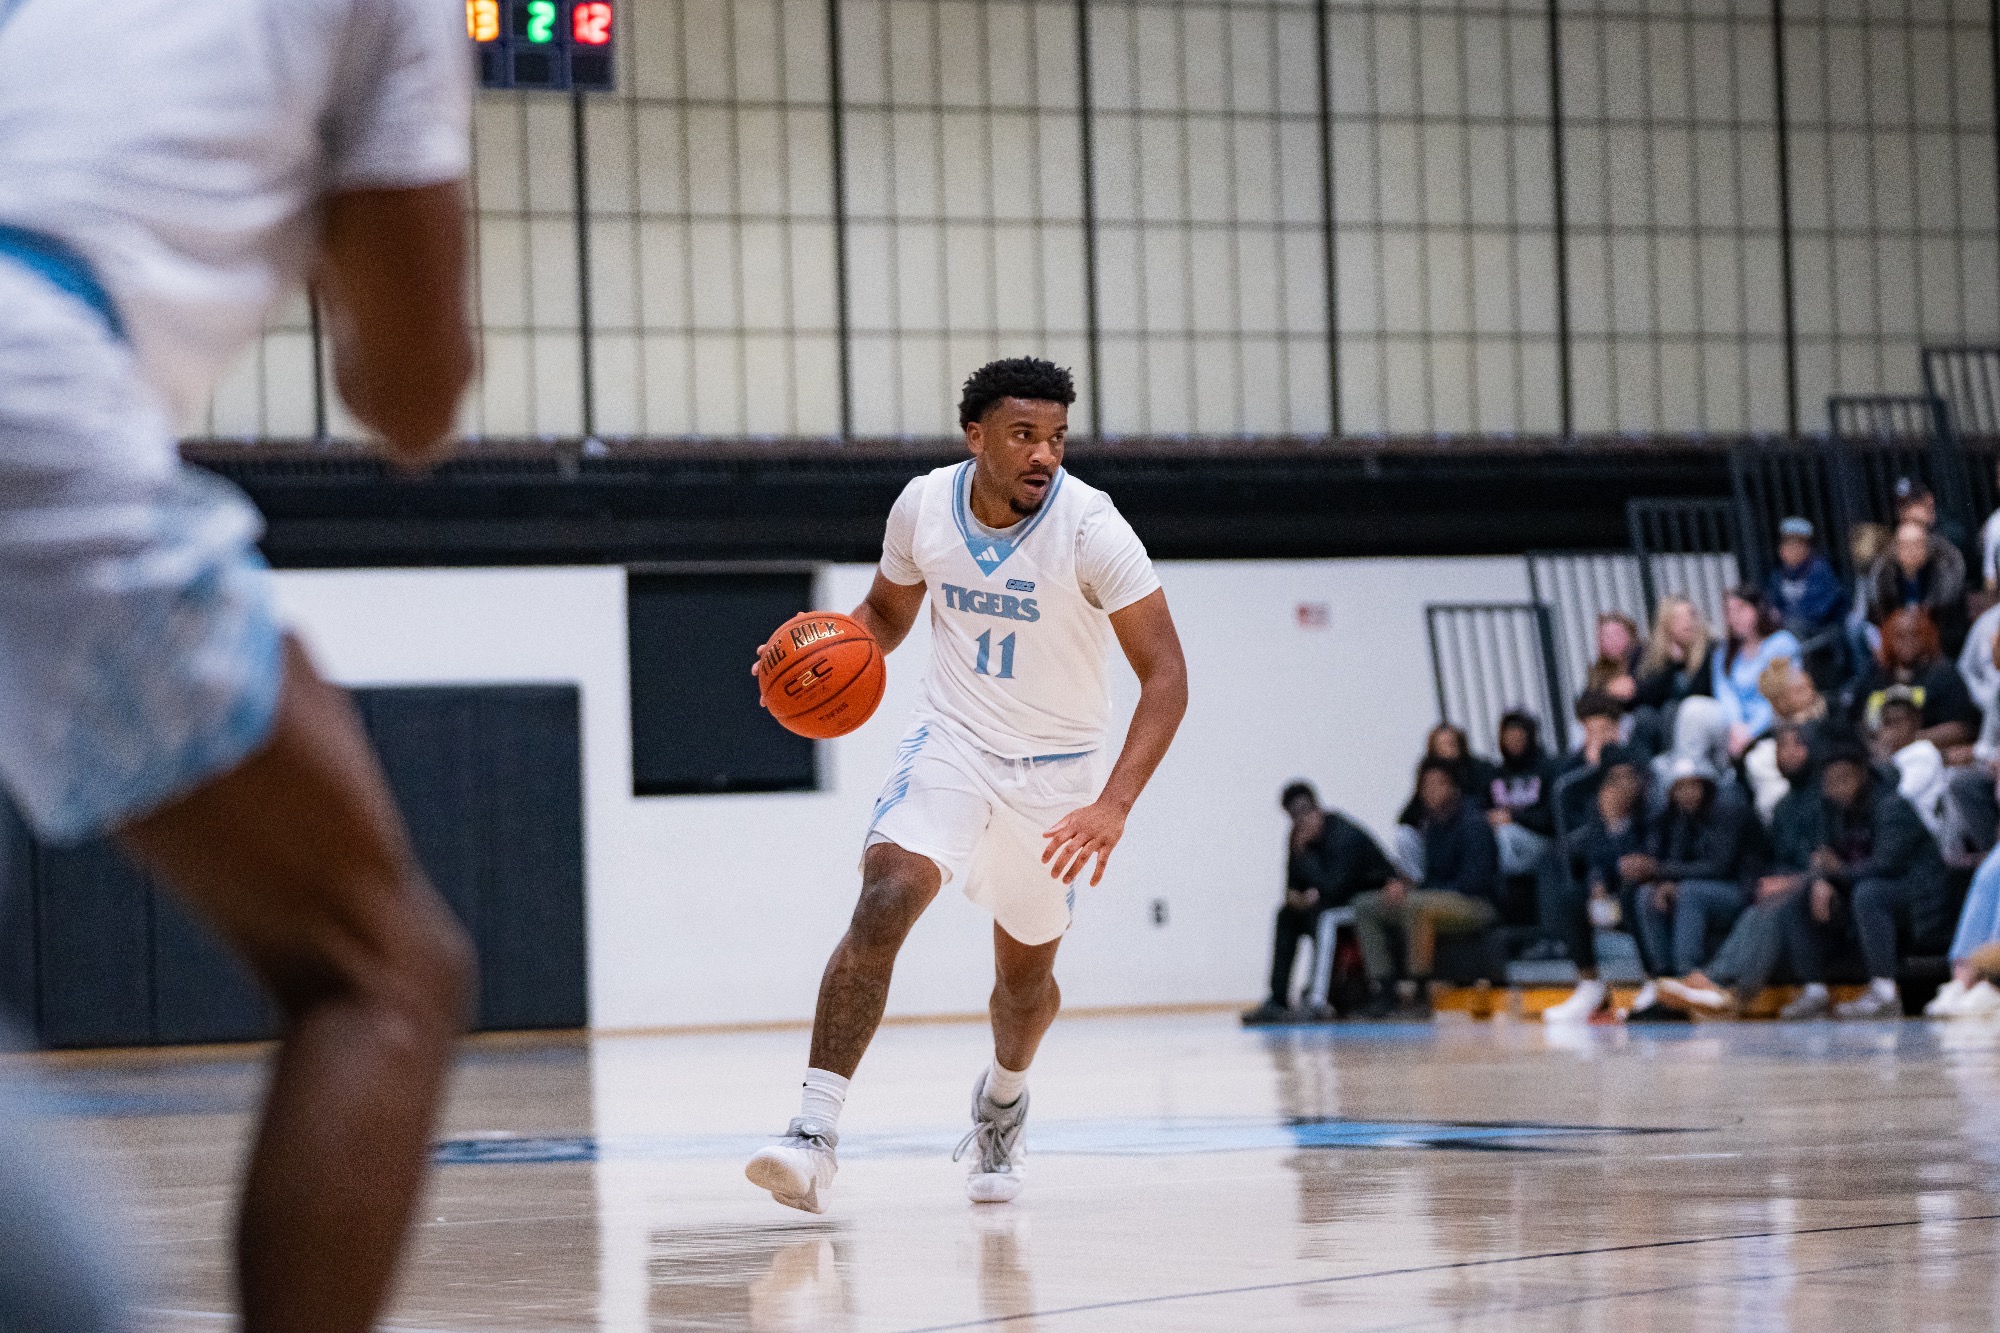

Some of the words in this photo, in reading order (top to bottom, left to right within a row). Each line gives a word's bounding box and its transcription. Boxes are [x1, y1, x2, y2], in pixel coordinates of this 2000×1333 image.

[527, 0, 556, 43] 2
[573, 2, 613, 45] 12
[941, 583, 1041, 622] TIGERS
[761, 638, 787, 676] THE
[789, 621, 842, 651] ROCK
[974, 627, 1016, 679] 11
